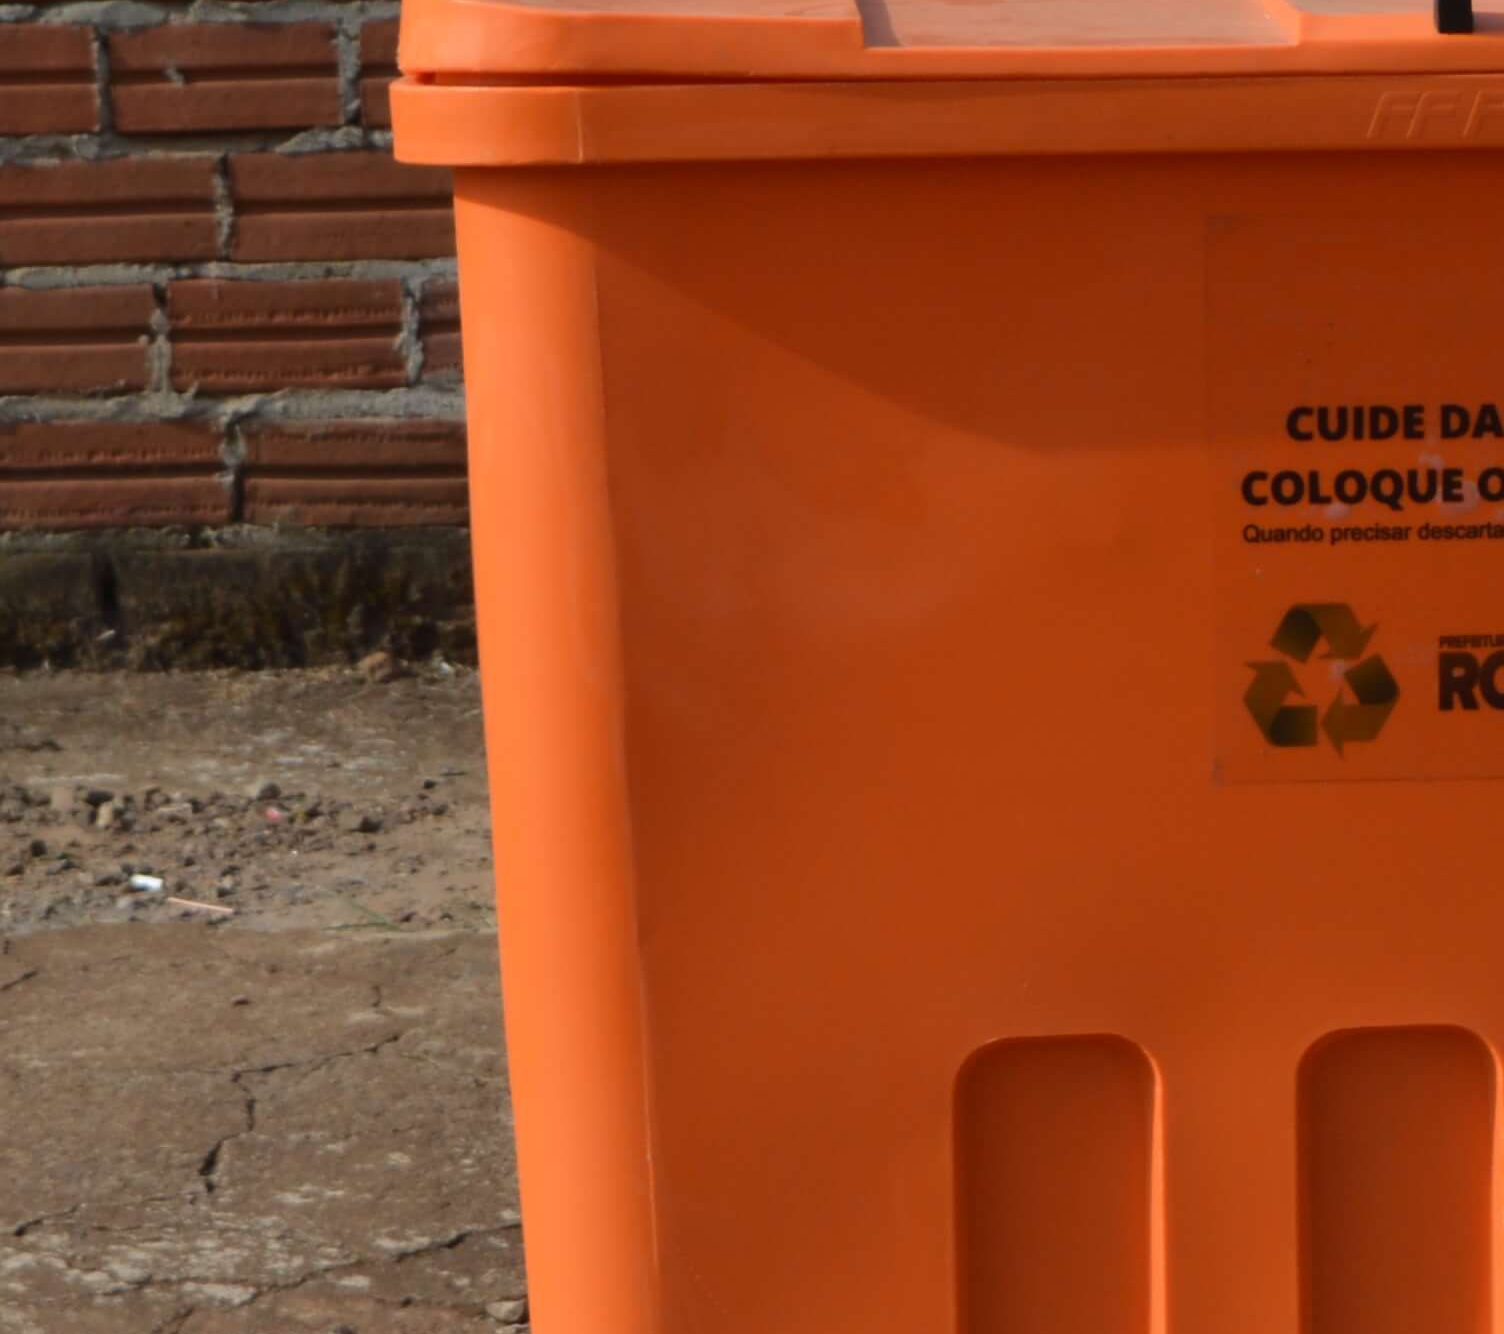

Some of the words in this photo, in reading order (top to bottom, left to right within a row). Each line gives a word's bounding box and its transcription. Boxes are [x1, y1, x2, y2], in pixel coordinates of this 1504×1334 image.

[1286, 404, 1425, 441] CUIDE
[1439, 403, 1504, 439] DA
[1240, 468, 1465, 511] COLOQUE
[1242, 523, 1325, 544] Quando
[1330, 523, 1411, 547] precisar
